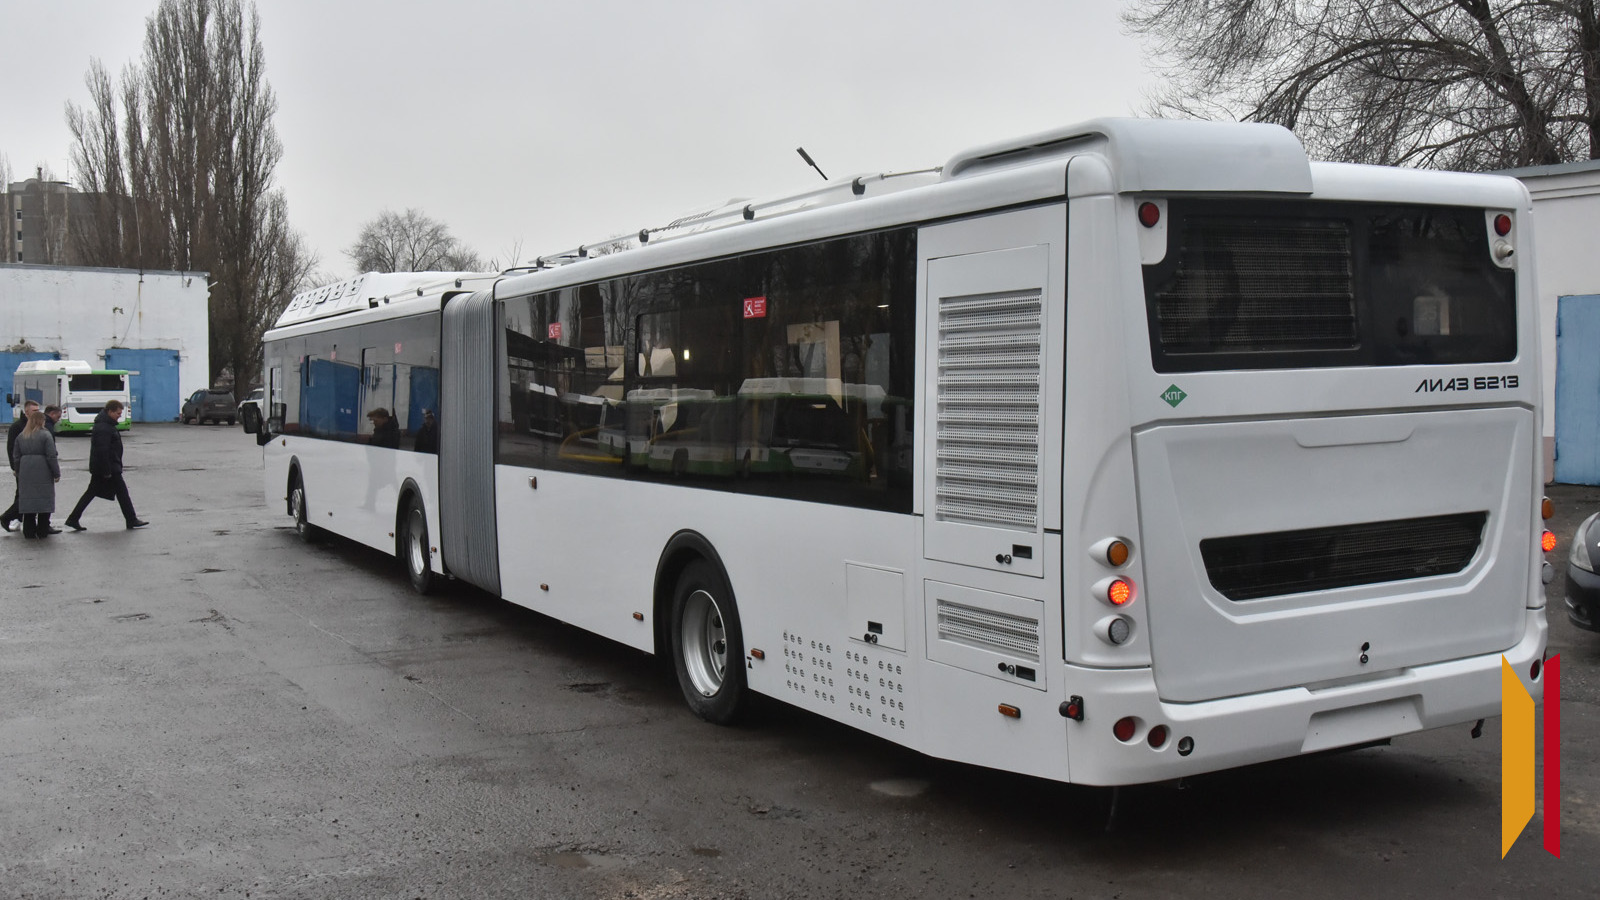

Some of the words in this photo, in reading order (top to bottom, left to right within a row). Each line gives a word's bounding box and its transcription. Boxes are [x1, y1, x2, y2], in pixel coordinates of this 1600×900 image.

[1415, 378, 1469, 392] ЛИАЗ
[1474, 375, 1519, 389] 6213
[1165, 391, 1181, 400] КПГ
